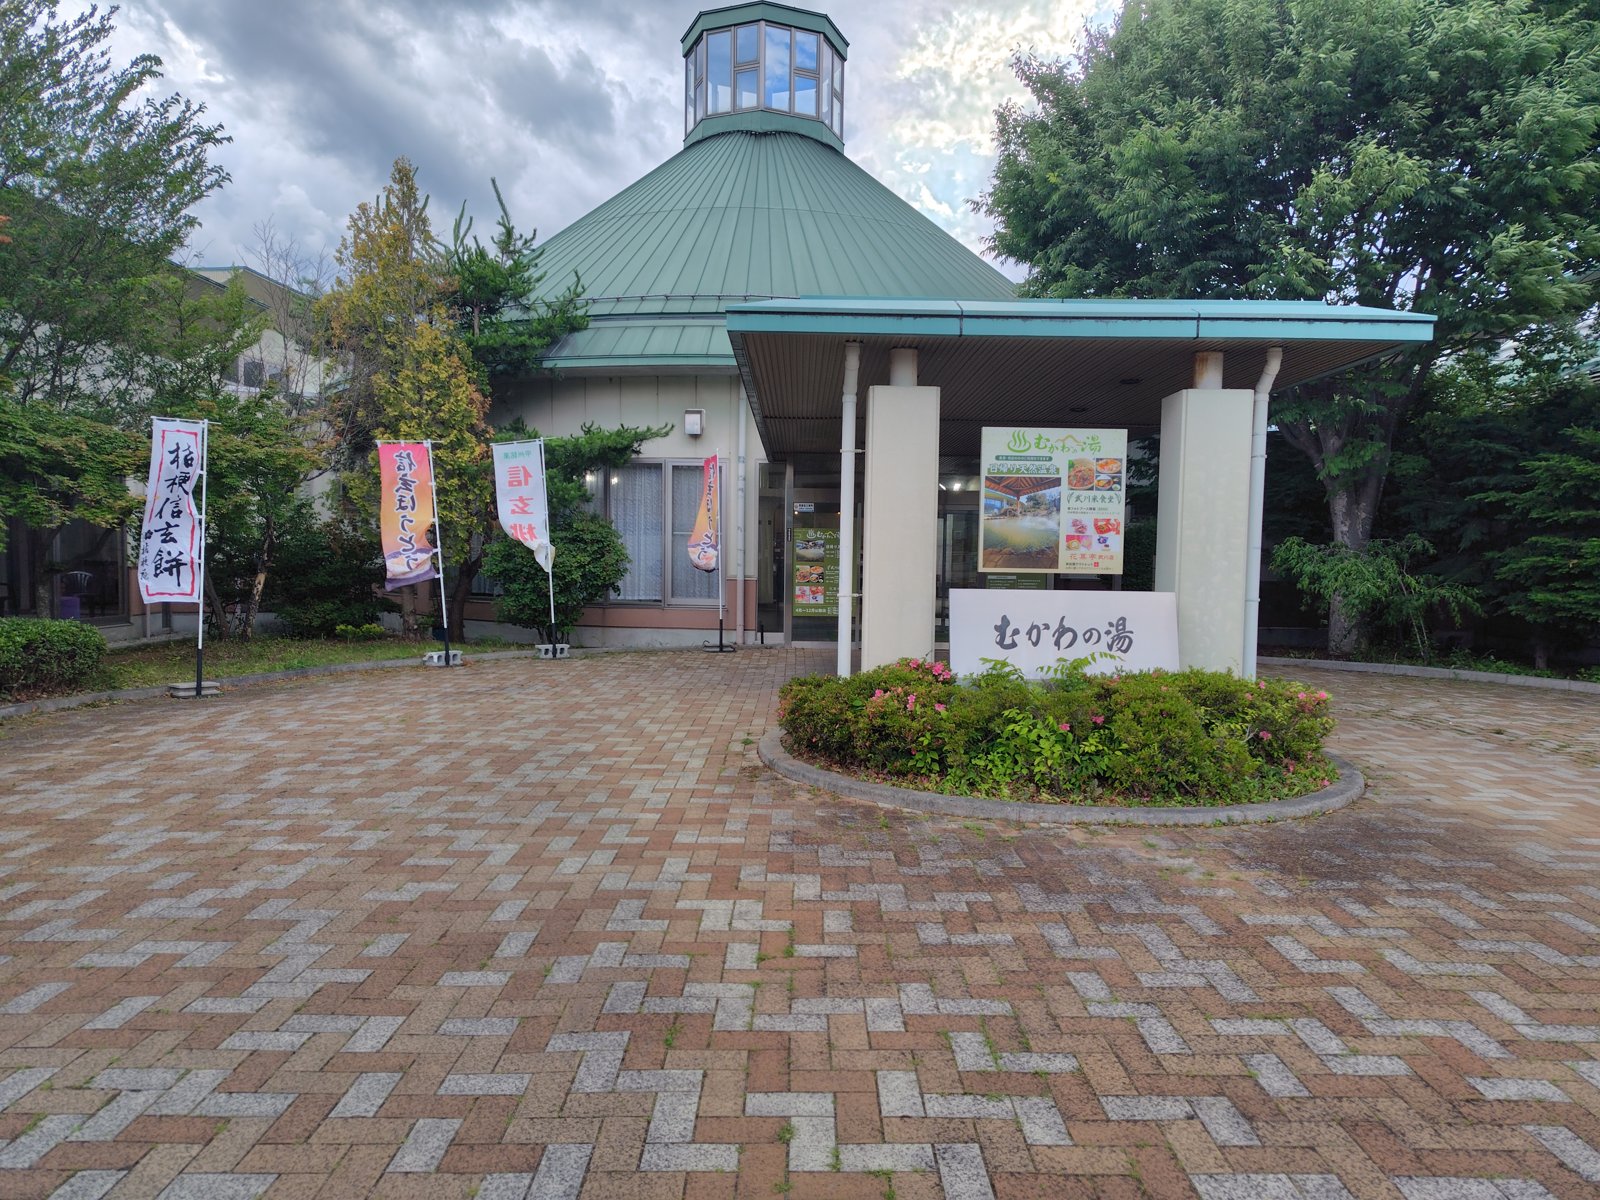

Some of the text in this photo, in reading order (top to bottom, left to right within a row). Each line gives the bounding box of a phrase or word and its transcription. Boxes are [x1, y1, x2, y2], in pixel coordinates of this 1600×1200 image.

[989, 462, 1058, 475] 日帰り天然温泉
[153, 442, 195, 588] 桔梗信玄餅
[994, 614, 1134, 654] むかわの湯
